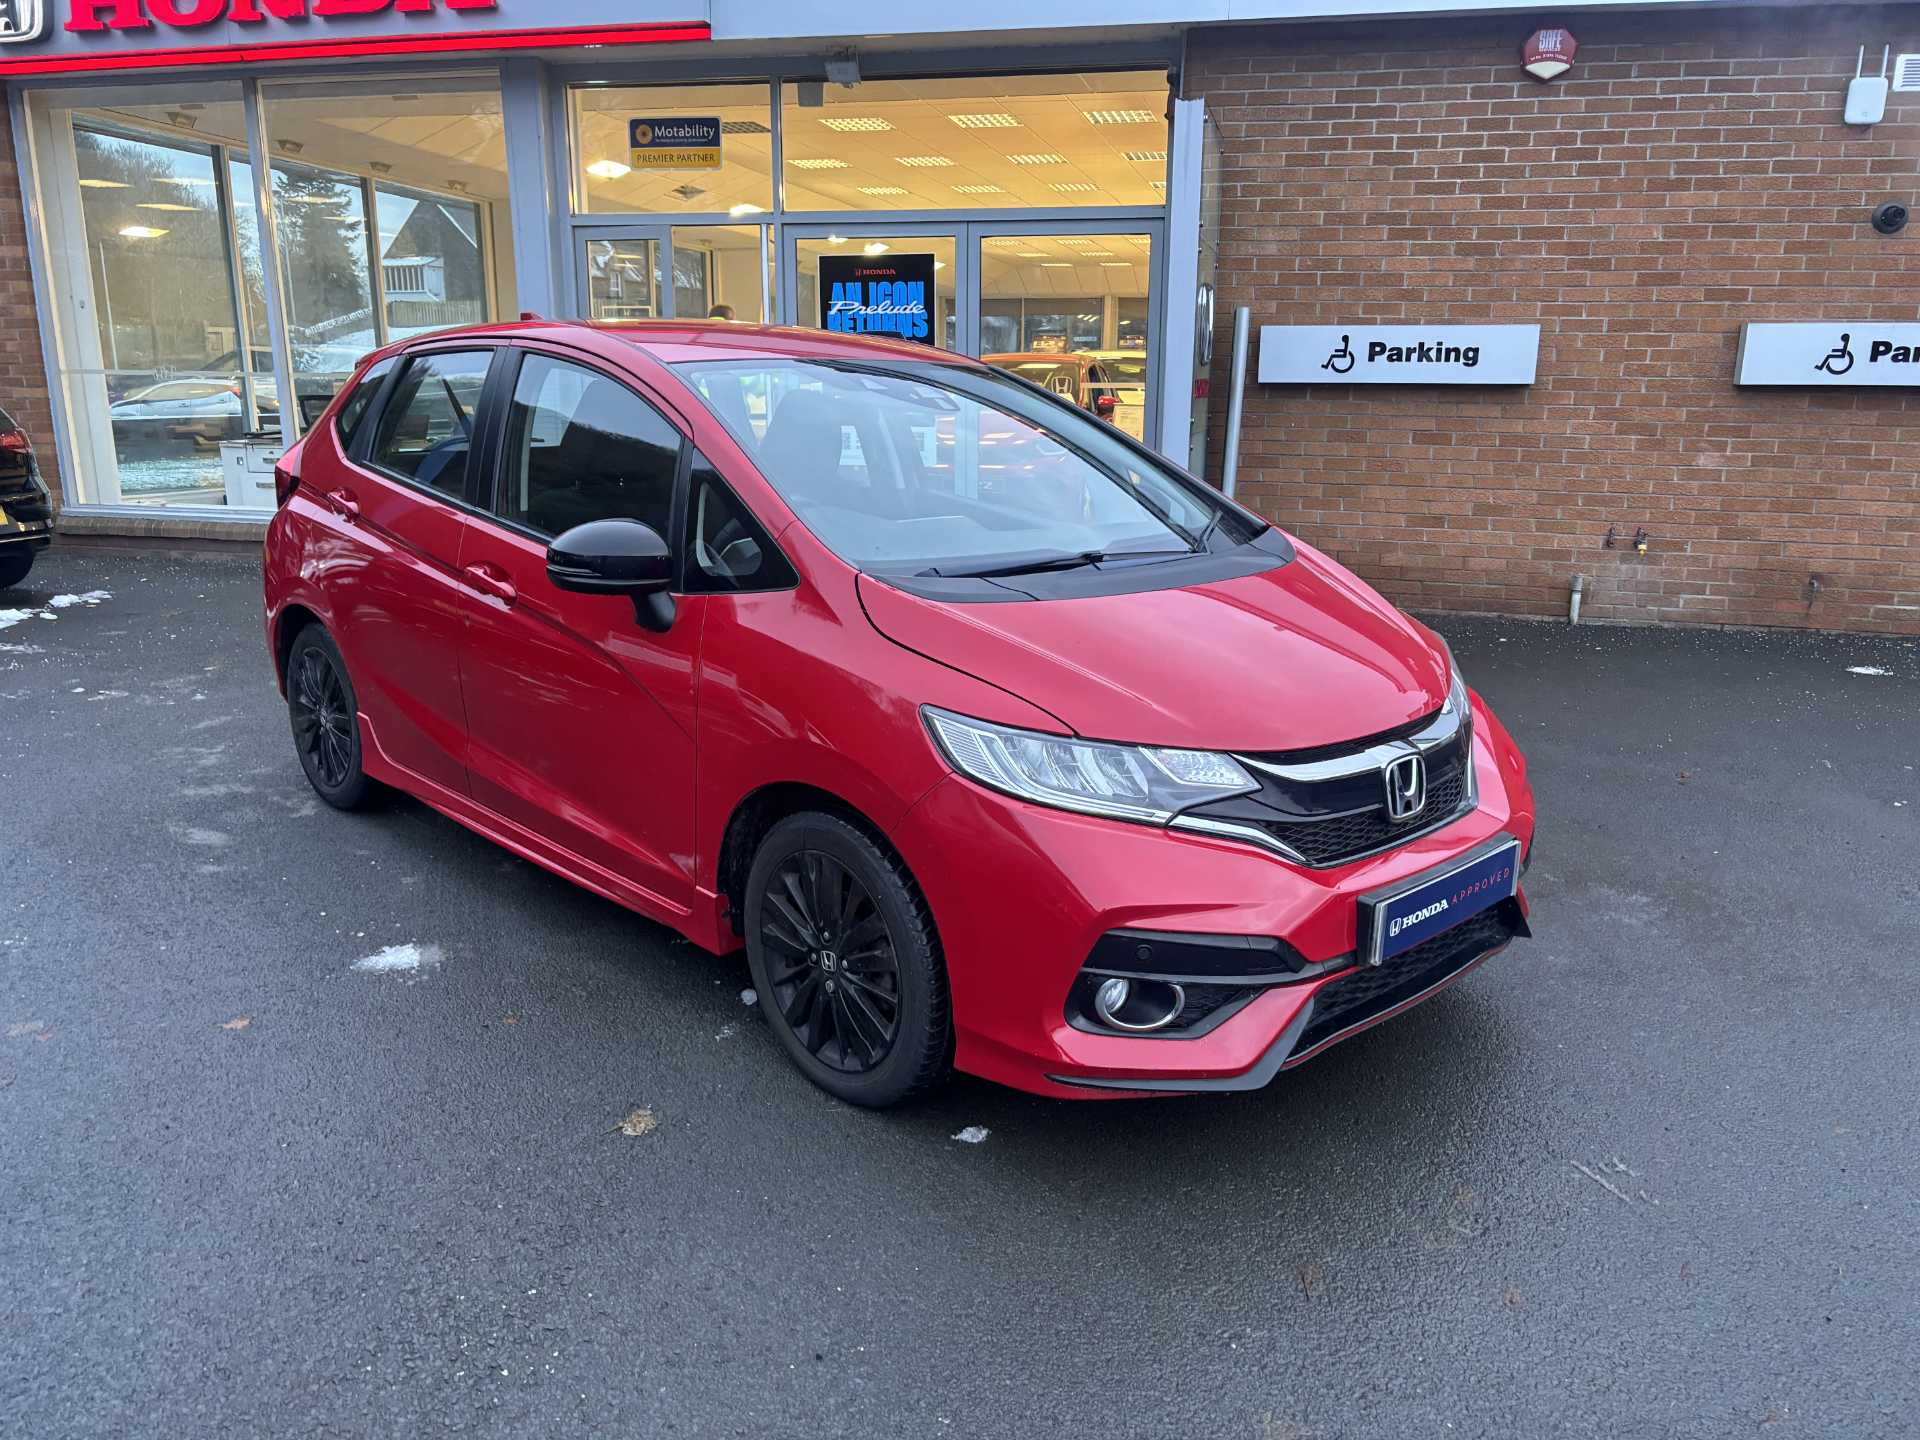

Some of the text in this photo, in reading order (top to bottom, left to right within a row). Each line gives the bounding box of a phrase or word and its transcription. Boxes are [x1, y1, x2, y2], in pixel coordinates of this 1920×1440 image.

[654, 124, 715, 139] Motability
[637, 153, 715, 163] PREMIER PARTNER
[863, 268, 897, 276] HONDA
[831, 281, 925, 310] AN ICON
[827, 300, 927, 315] Prelude
[1367, 341, 1480, 368] Parking
[1401, 898, 1449, 929] HONDA
[1451, 867, 1510, 905] APPROVED
